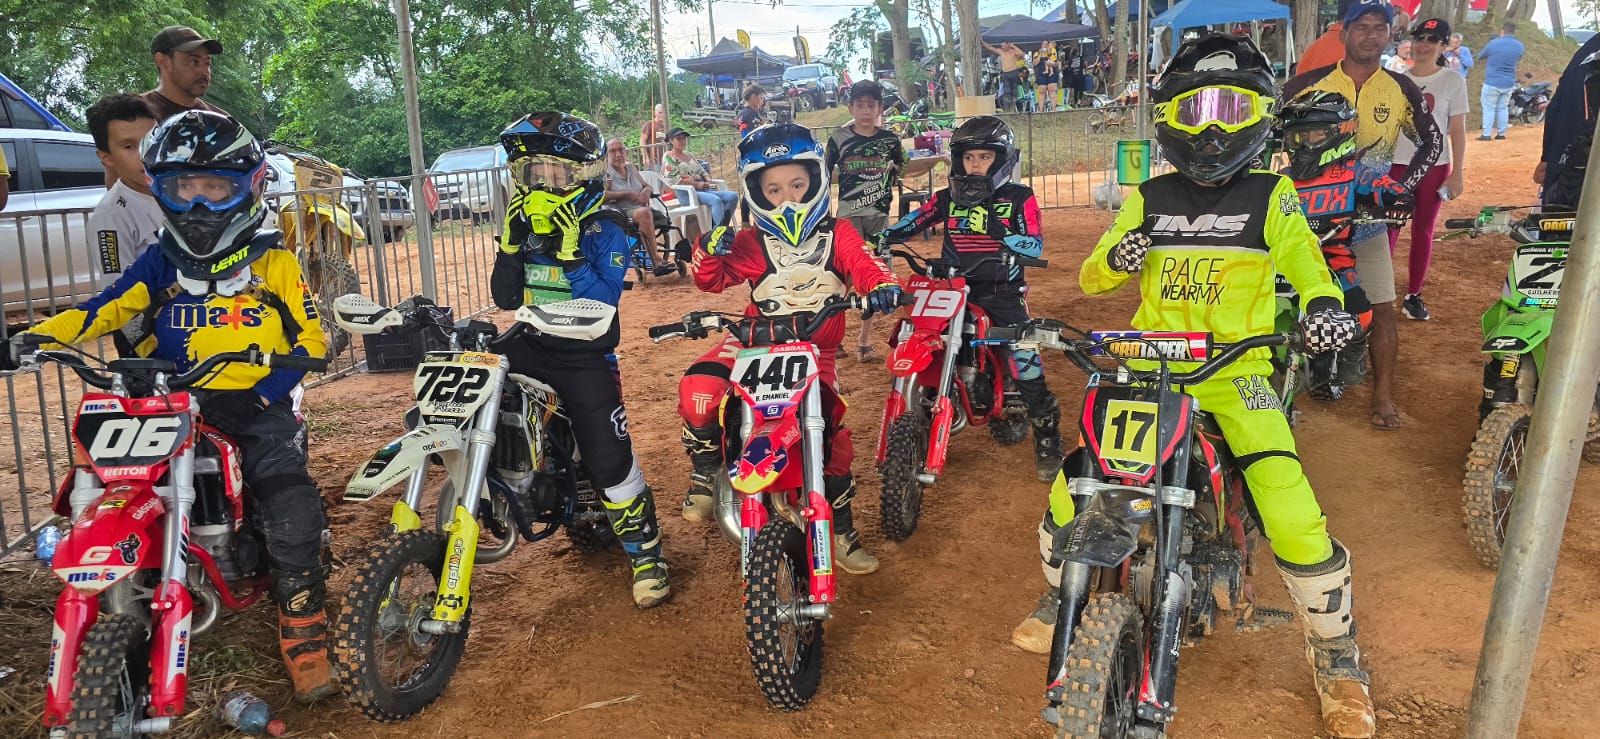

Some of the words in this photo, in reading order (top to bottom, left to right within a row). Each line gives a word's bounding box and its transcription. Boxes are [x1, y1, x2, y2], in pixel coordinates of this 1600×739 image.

[1148, 214, 1251, 234] IMS
[106, 231, 118, 272] FEDERAL
[210, 244, 251, 274] LEATT
[1161, 256, 1225, 286] RACE
[911, 289, 963, 318] 19
[773, 345, 808, 353] GASGAS
[416, 366, 491, 404] 722
[740, 355, 809, 394] 440
[88, 416, 183, 462] 06
[1110, 409, 1156, 453] 17
[104, 466, 149, 477] HEITOR
